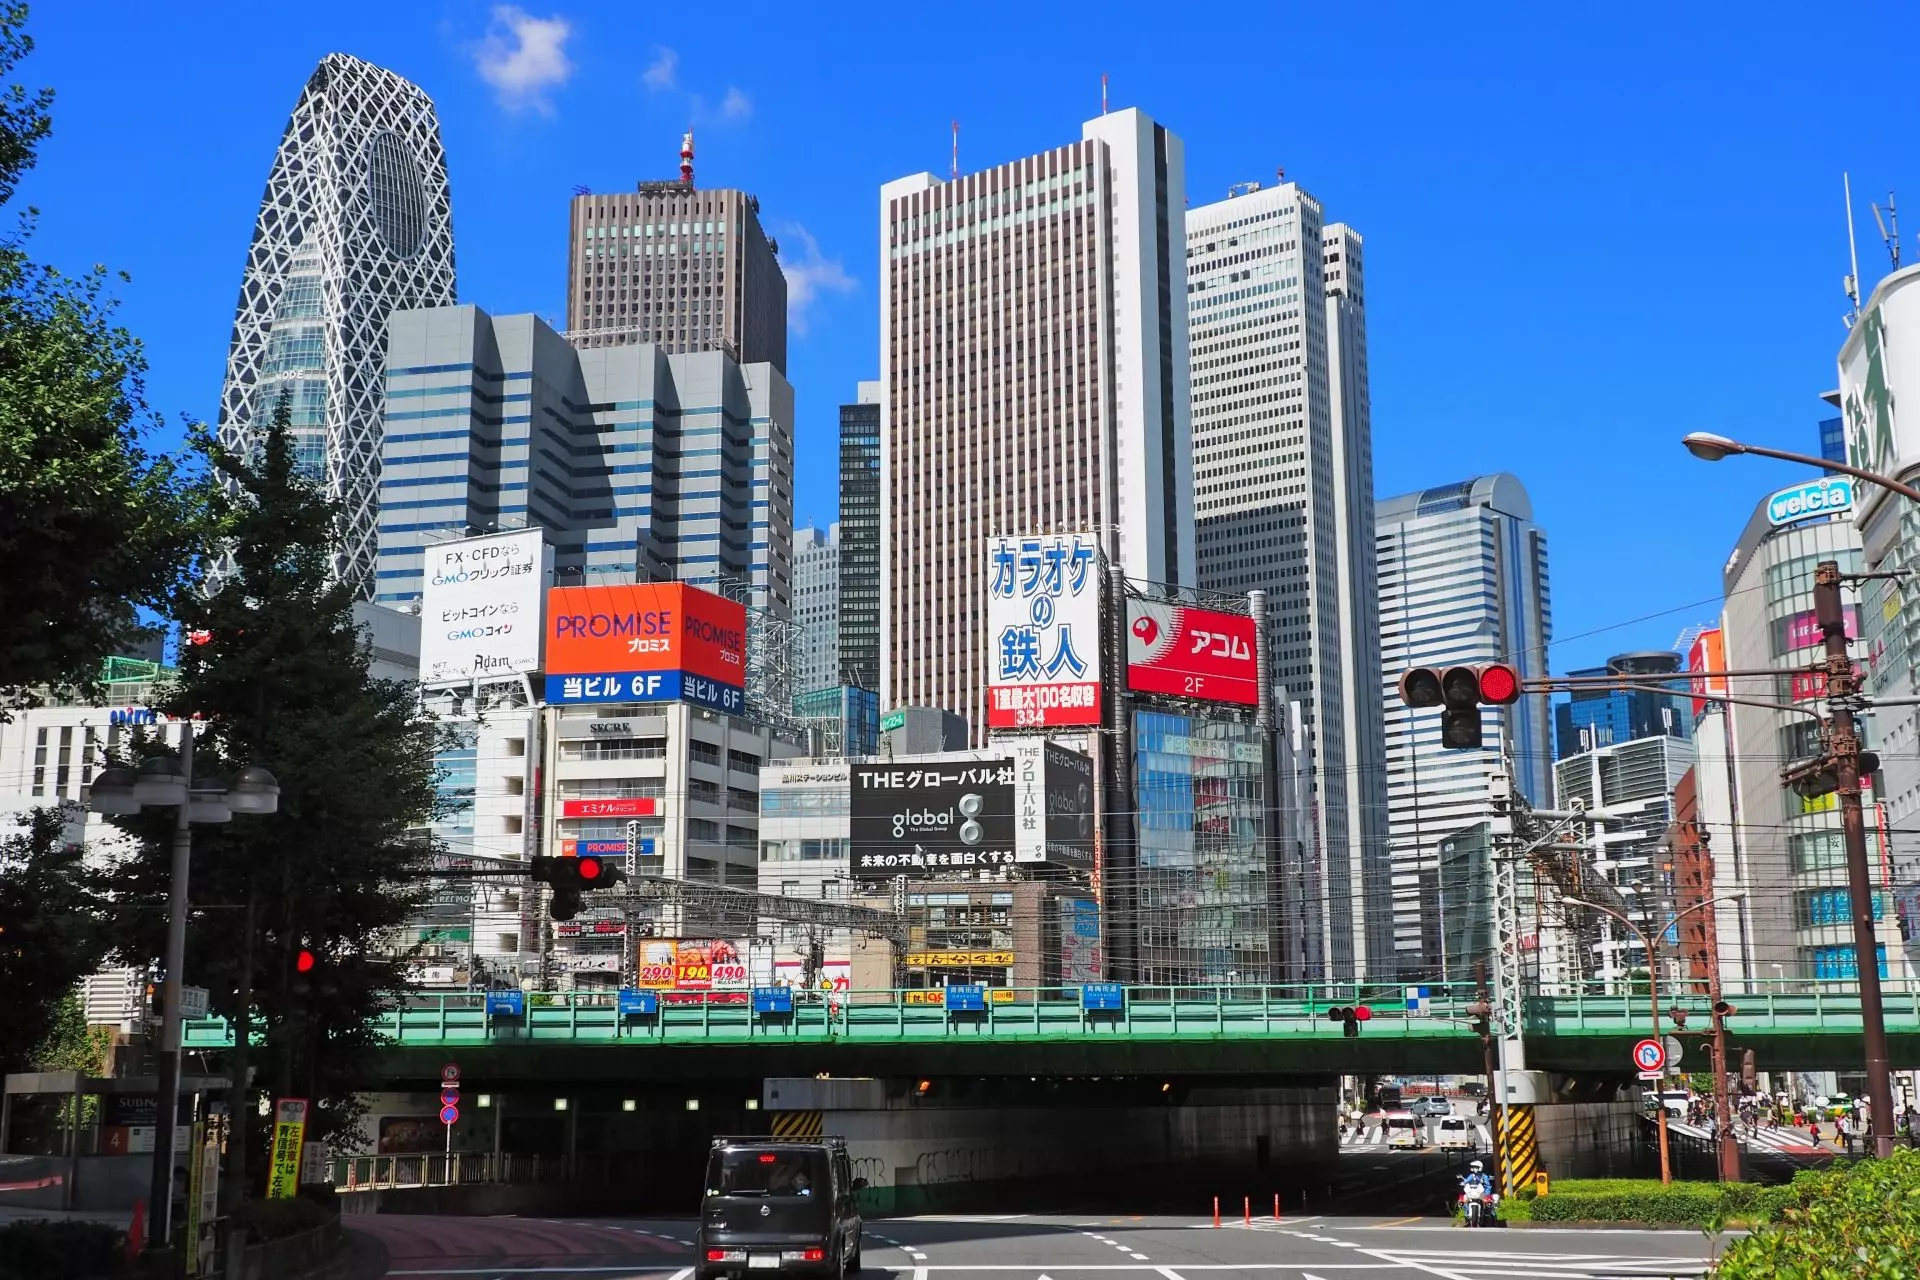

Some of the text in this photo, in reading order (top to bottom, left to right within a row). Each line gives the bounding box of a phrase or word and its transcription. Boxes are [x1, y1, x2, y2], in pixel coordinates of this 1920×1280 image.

[1772, 479, 1846, 519] welcia
[431, 562, 533, 586] GMOクリック証券
[990, 535, 1096, 599] カラオケ
[442, 601, 520, 622] ビットコインなら
[1029, 590, 1056, 629] の
[447, 623, 514, 641] GMOコイン
[556, 611, 672, 639] PROMISE
[684, 615, 741, 652] PROMISE
[627, 638, 671, 653] プロミス
[998, 624, 1088, 681] 鉄人
[1190, 629, 1251, 661] アコム
[473, 653, 511, 675] Adam
[719, 649, 741, 665] プロミス
[563, 675, 662, 698] 当ビル 6F
[683, 675, 741, 709] 当ビル 6F
[1184, 676, 1205, 694] 2F
[993, 686, 1096, 710] 1室最大100名収容
[590, 722, 631, 733] SECRE
[1016, 708, 1045, 725] 334
[1017, 747, 1040, 757] THE
[1045, 748, 1091, 776] THEグローバル社
[858, 766, 1015, 789] THEグローバル社
[1022, 759, 1037, 830] グローバル社
[892, 807, 954, 838] global
[587, 842, 627, 853] PROMISE
[640, 966, 672, 980] 290
[679, 966, 708, 980] 190
[713, 966, 745, 980] 490
[109, 1133, 121, 1147] 4
[285, 1125, 300, 1176] 左折車は
